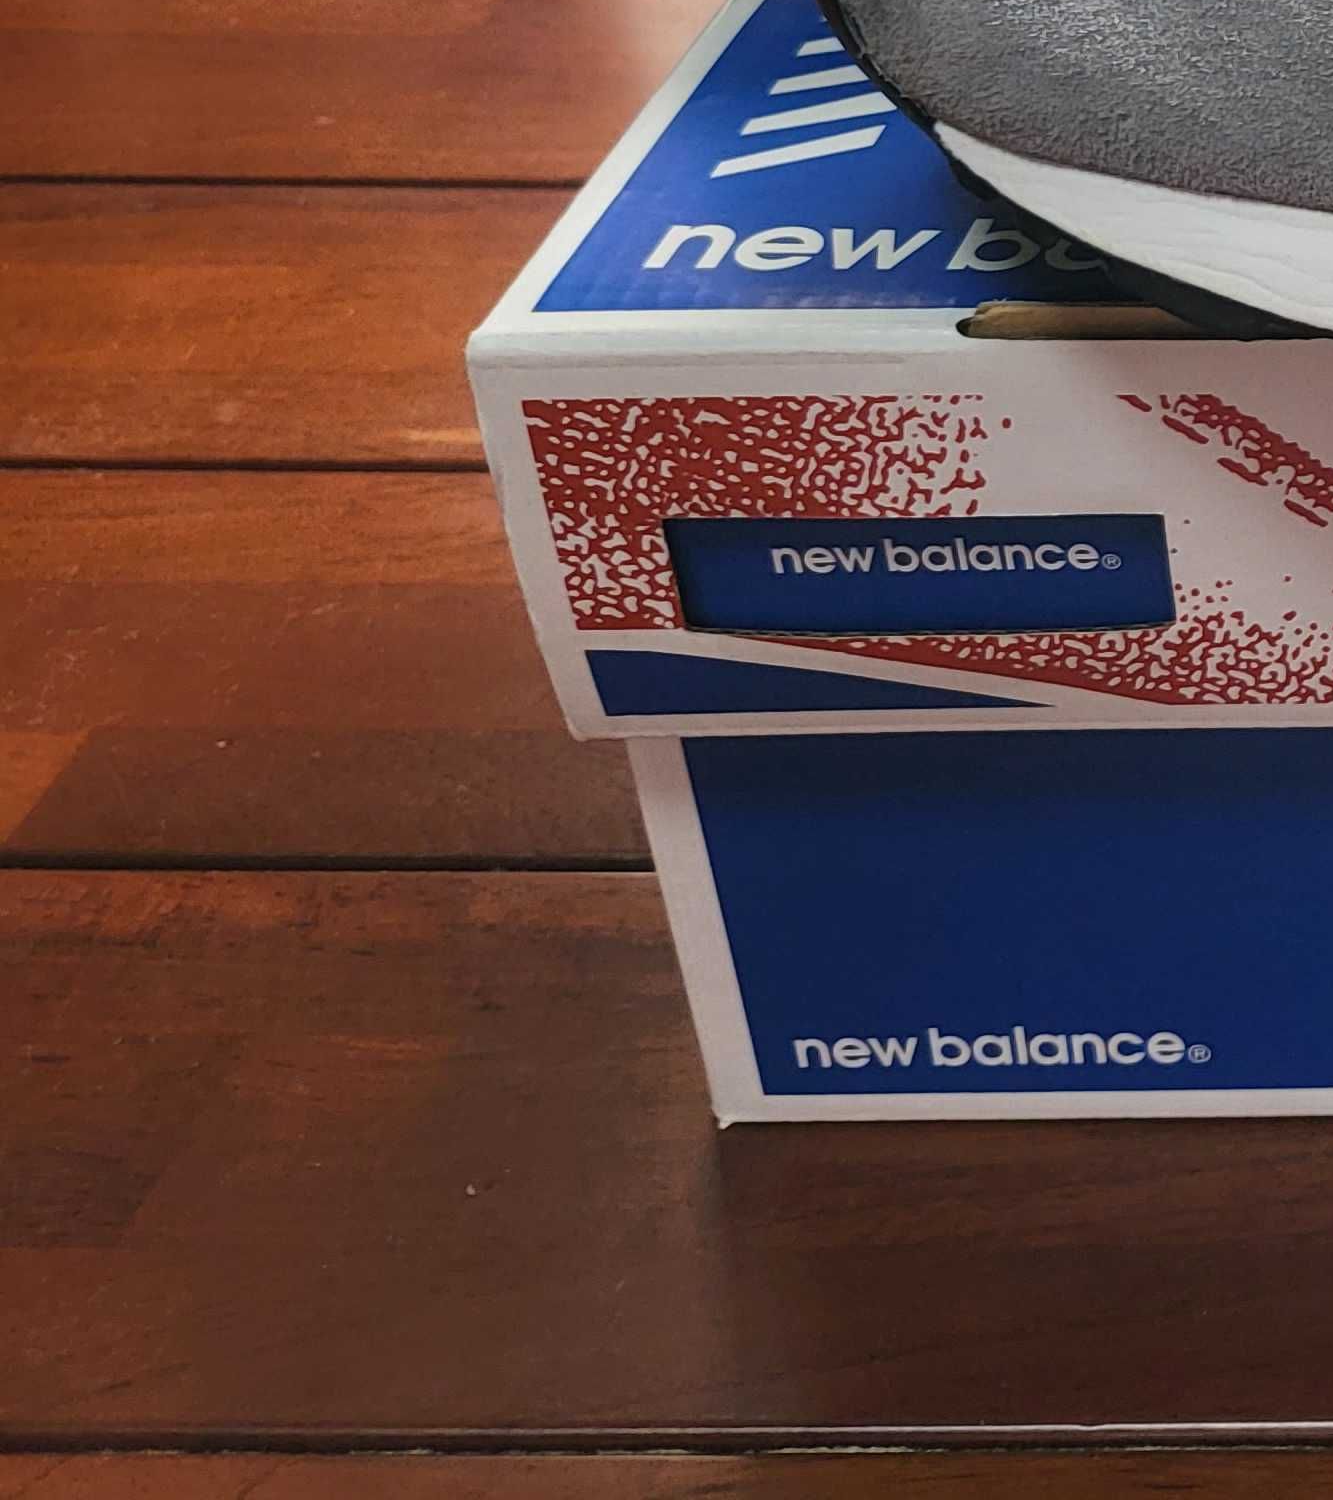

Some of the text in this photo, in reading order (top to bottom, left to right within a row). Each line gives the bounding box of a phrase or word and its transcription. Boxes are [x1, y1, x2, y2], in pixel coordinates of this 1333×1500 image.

[643, 221, 942, 271] new
[771, 544, 874, 575] new
[794, 1036, 918, 1069] new
